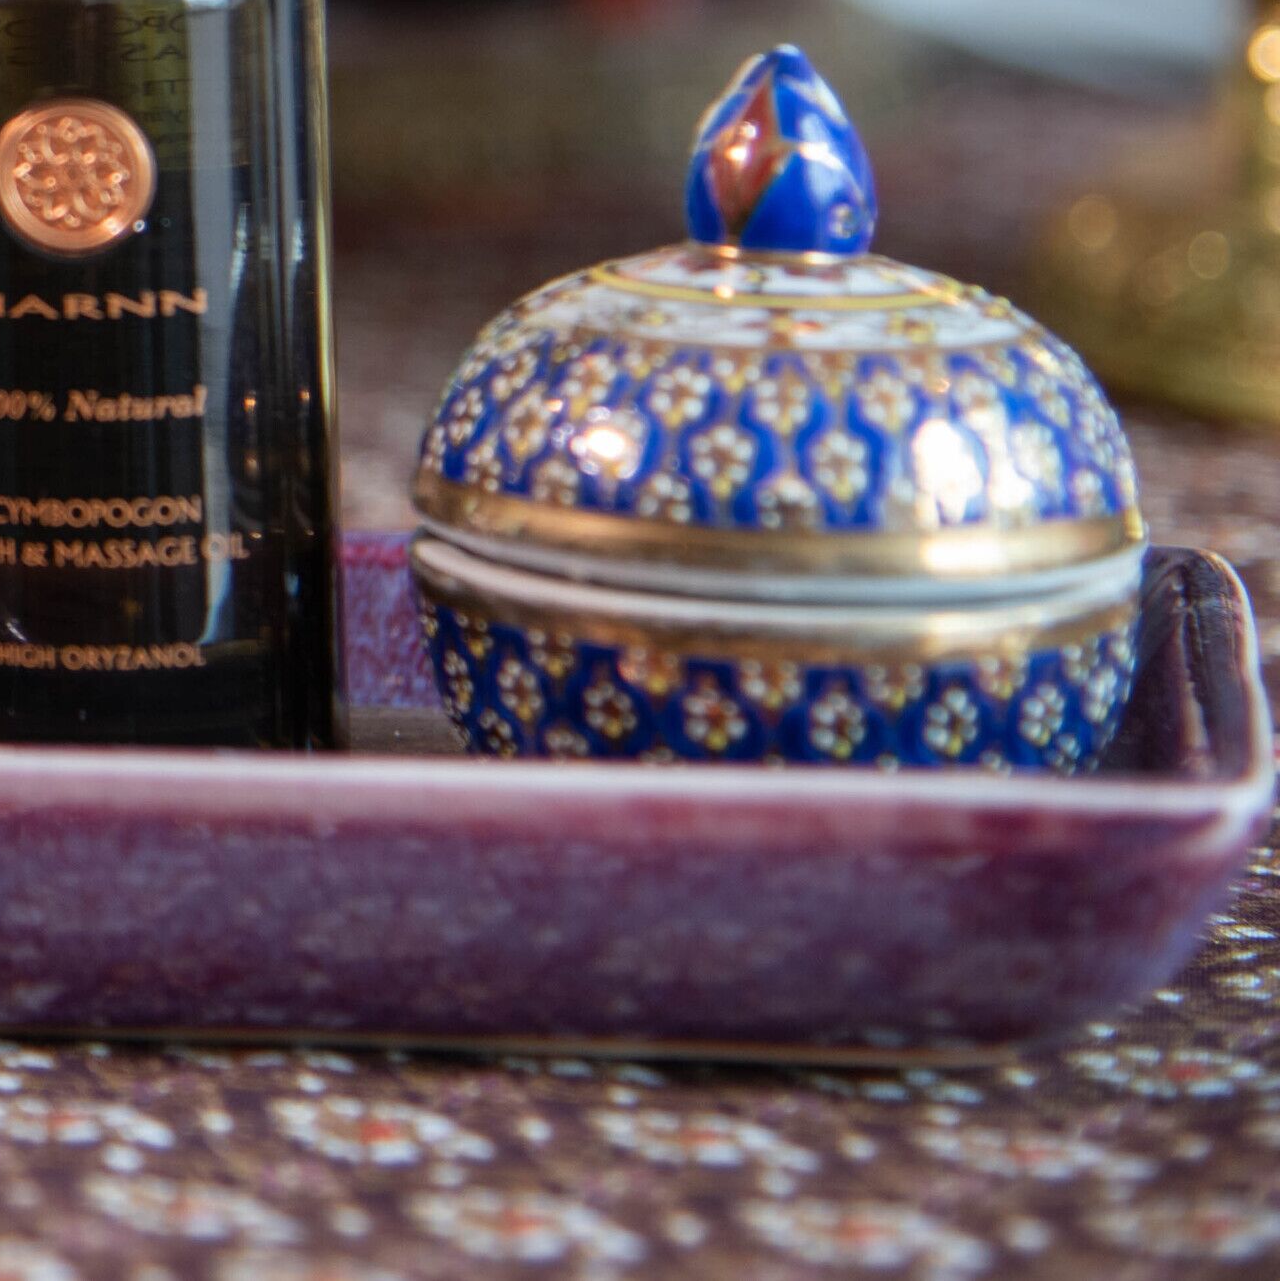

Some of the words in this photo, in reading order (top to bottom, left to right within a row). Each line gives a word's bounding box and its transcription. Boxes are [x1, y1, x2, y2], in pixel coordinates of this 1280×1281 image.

[64, 384, 208, 422] Natural
[20, 542, 48, 567] &
[53, 536, 196, 569] MASSAGE
[201, 532, 250, 564] OIL
[60, 641, 206, 671] ORYZANOL
